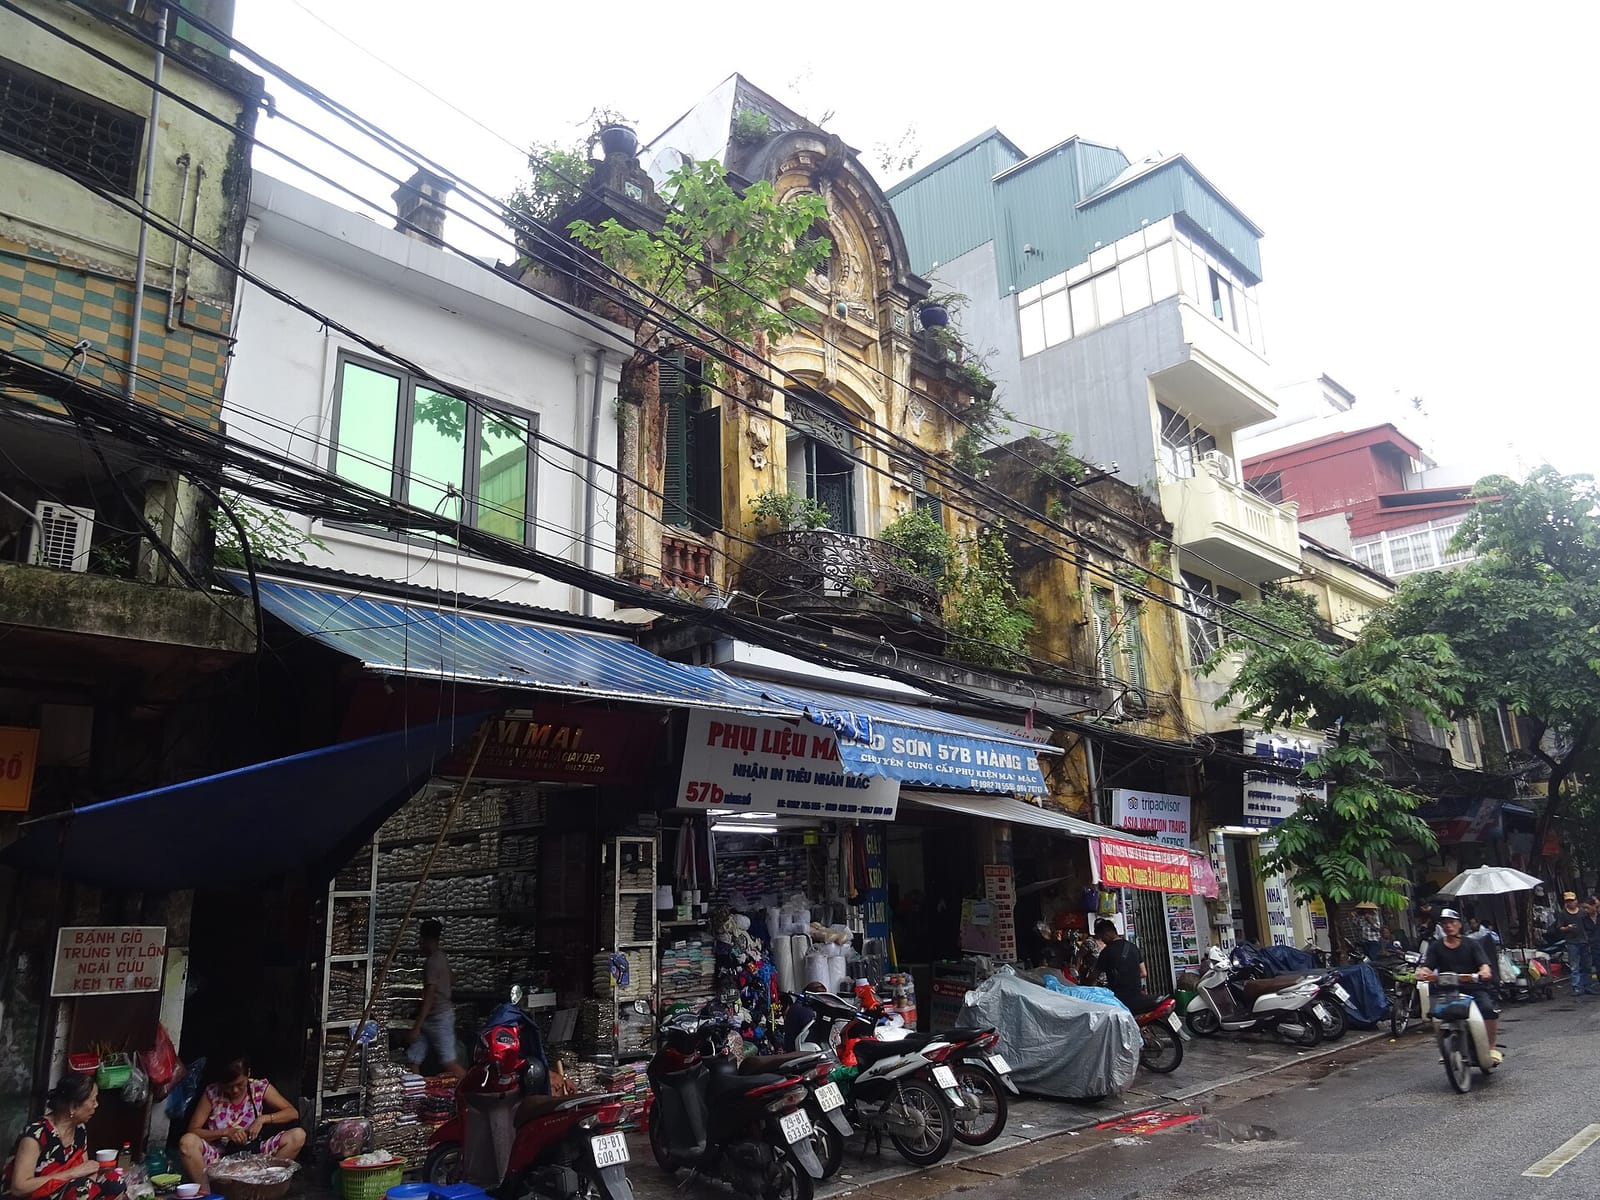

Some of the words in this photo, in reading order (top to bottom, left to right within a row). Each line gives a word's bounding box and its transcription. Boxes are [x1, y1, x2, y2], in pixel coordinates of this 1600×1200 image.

[707, 721, 757, 756] PHỤ
[760, 727, 807, 760] LIỆU
[892, 737, 931, 758] SƠN
[938, 744, 971, 763] 57B
[975, 747, 1021, 771] HÀNG
[732, 762, 768, 782] NHẬN
[770, 767, 783, 780] IN
[786, 767, 811, 783] THÊU
[814, 769, 845, 787] NHÃN
[845, 774, 870, 790] MÁC
[907, 761, 933, 771] CUNG
[954, 767, 975, 778] PHỤ
[685, 781, 725, 804] 57b
[1141, 798, 1181, 814] tripadvisor
[1123, 815, 1138, 830] ASIA
[1140, 817, 1167, 832] VACATION
[1168, 819, 1187, 833] TRAVEL
[1266, 885, 1281, 903] NHÀ
[75, 929, 115, 944] BÁNH
[73, 978, 101, 990] KEM
[106, 976, 153, 990] TRNG
